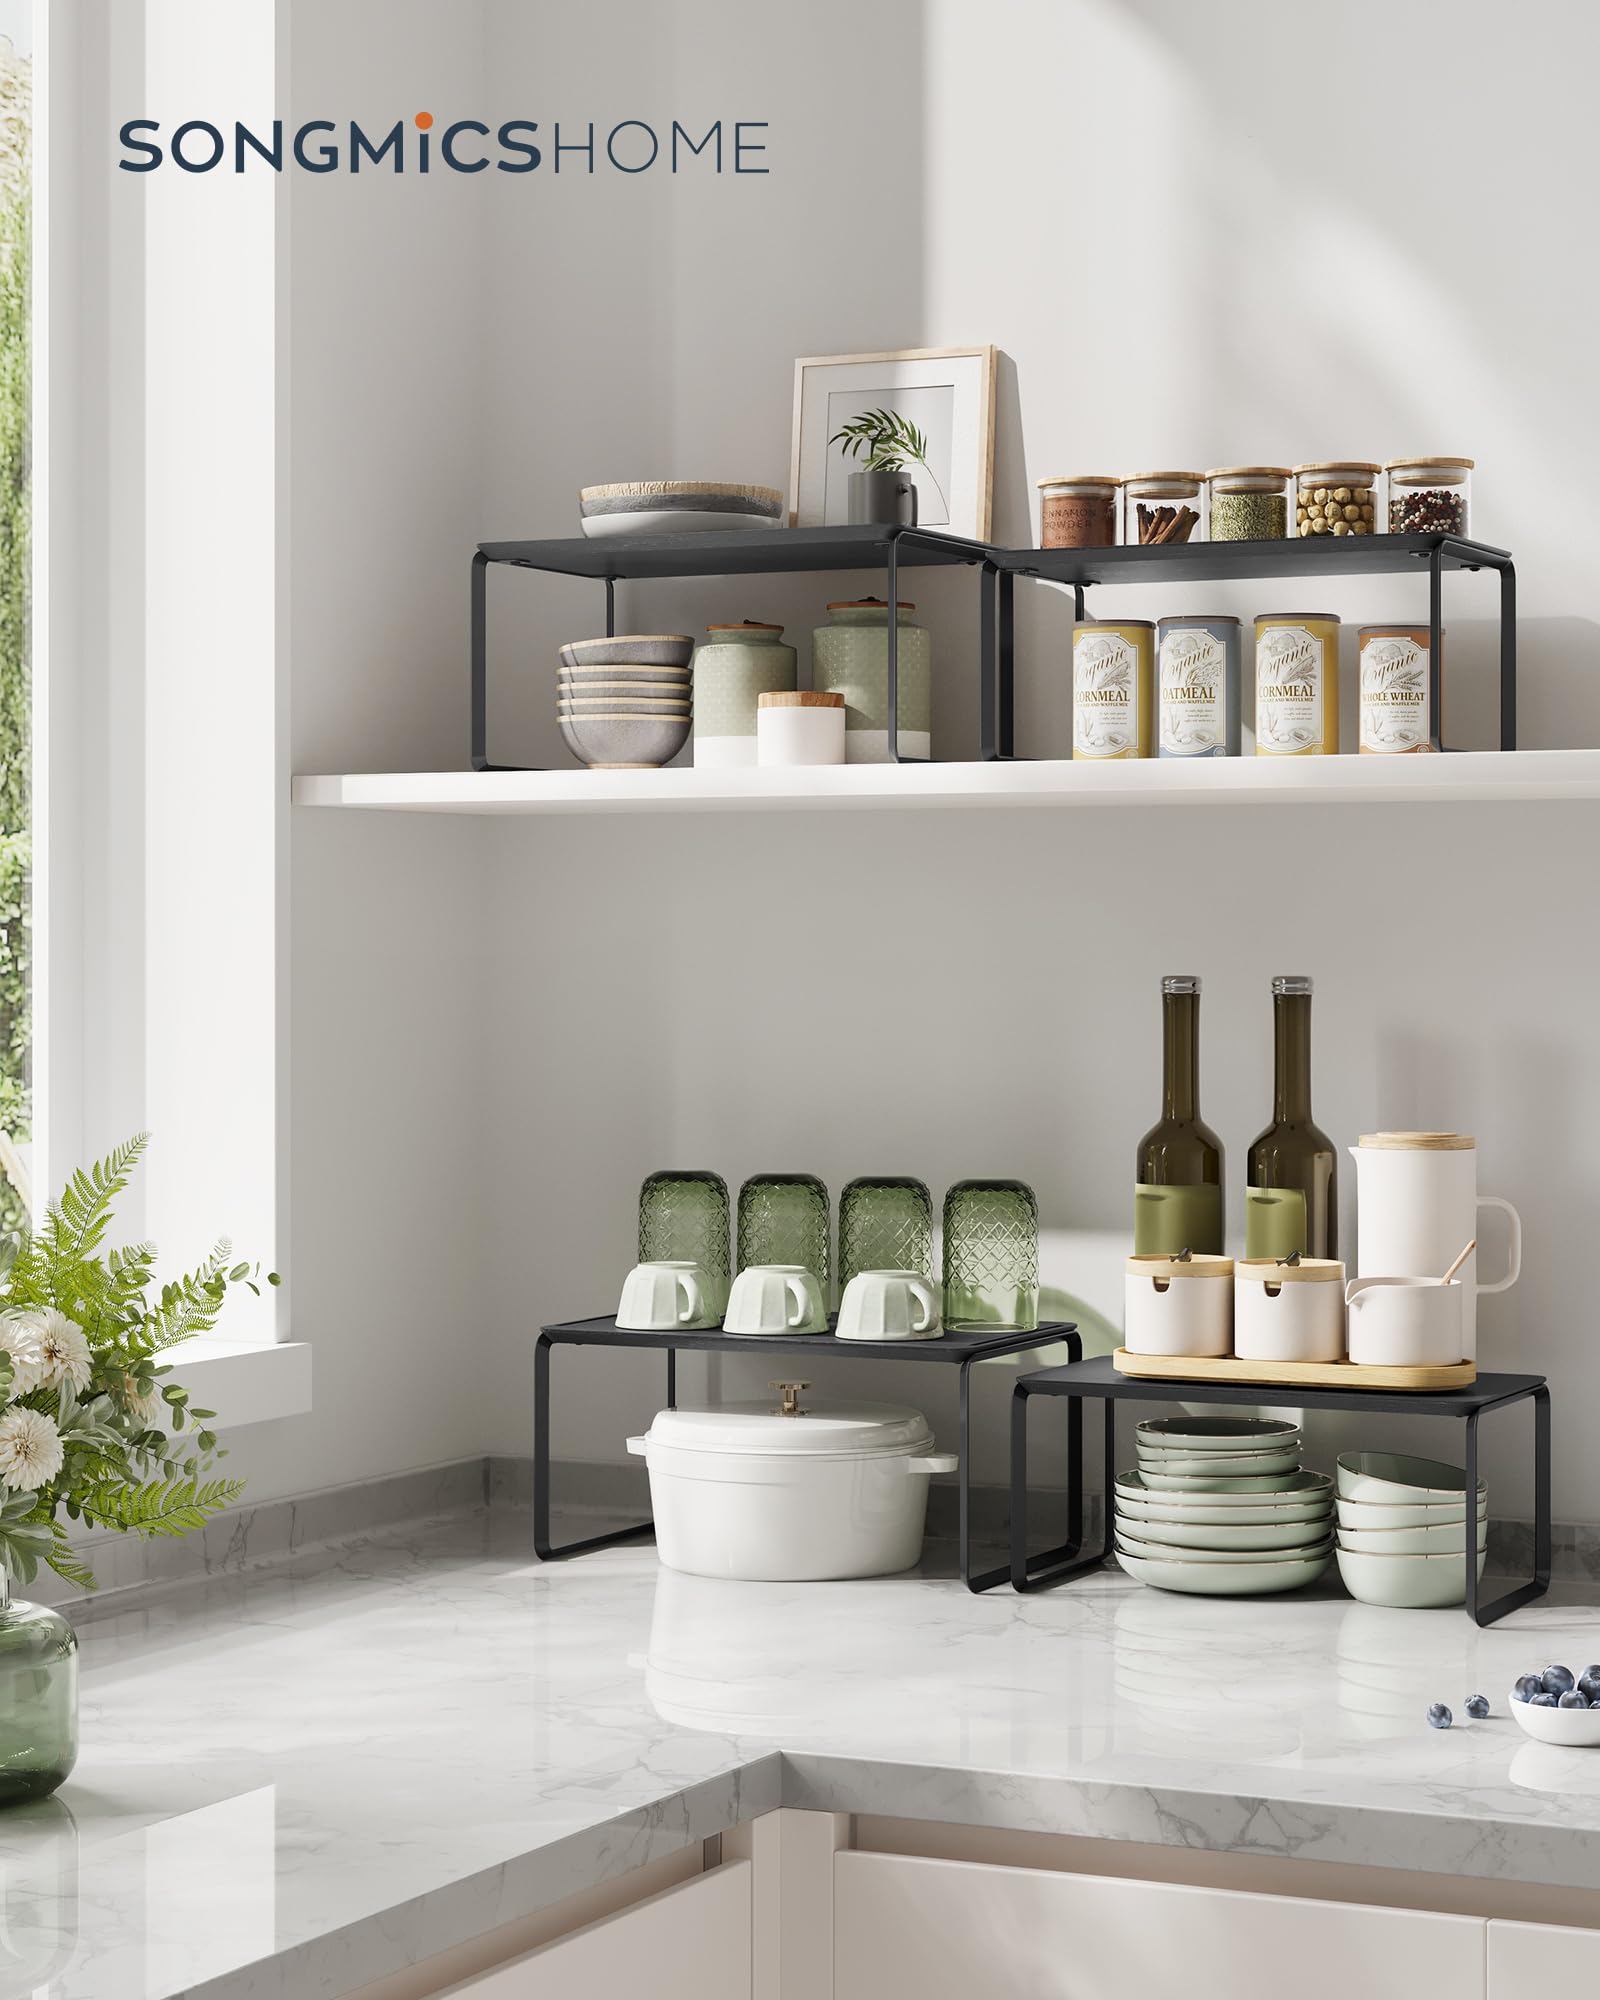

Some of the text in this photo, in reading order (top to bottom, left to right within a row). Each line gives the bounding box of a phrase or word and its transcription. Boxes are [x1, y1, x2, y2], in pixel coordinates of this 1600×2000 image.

[1042, 508, 1097, 519] NNAMON
[1162, 686, 1216, 700] OATMEAL
[1390, 692, 1426, 702] WHEAT
